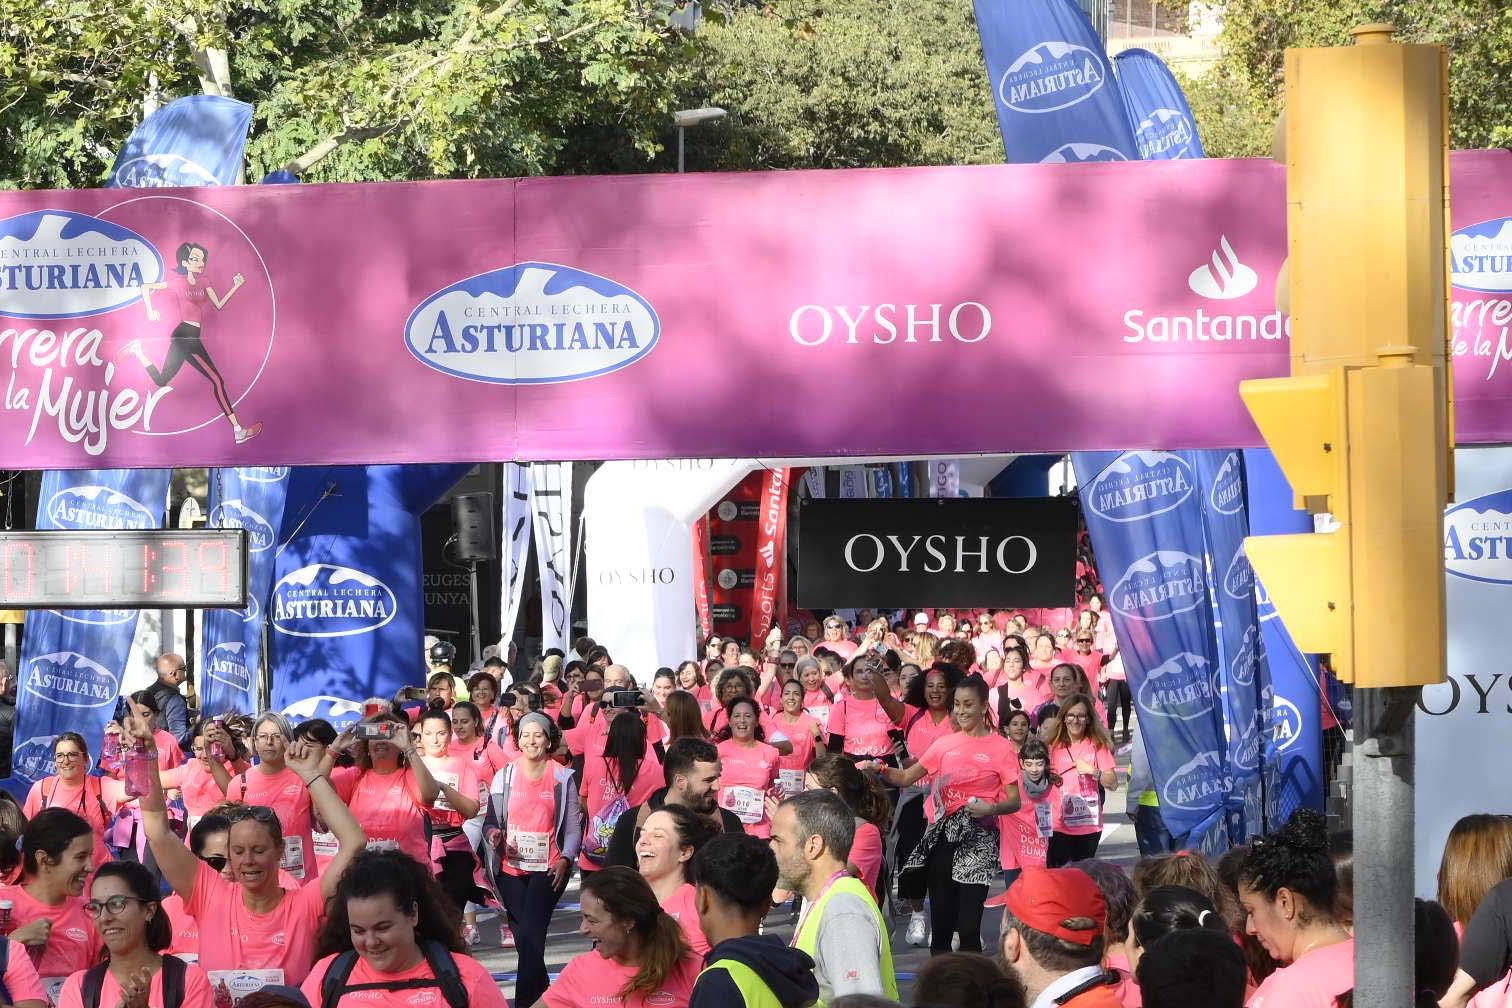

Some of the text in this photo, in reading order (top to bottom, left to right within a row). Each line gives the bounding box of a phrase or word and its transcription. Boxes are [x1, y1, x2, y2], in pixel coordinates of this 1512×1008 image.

[68, 245, 139, 258] LECHERA
[464, 303, 632, 318] CENTRAL LECHERA
[790, 302, 992, 346] OYSHO
[424, 310, 640, 355] ASTURIANA
[5, 373, 29, 410] la
[25, 361, 174, 455] Mujer
[844, 533, 1038, 574] OYSHO
[275, 594, 386, 621] ASTURIANA
[287, 587, 382, 598] CENTRAL LECHERA
[26, 668, 110, 699] ASTURIANA
